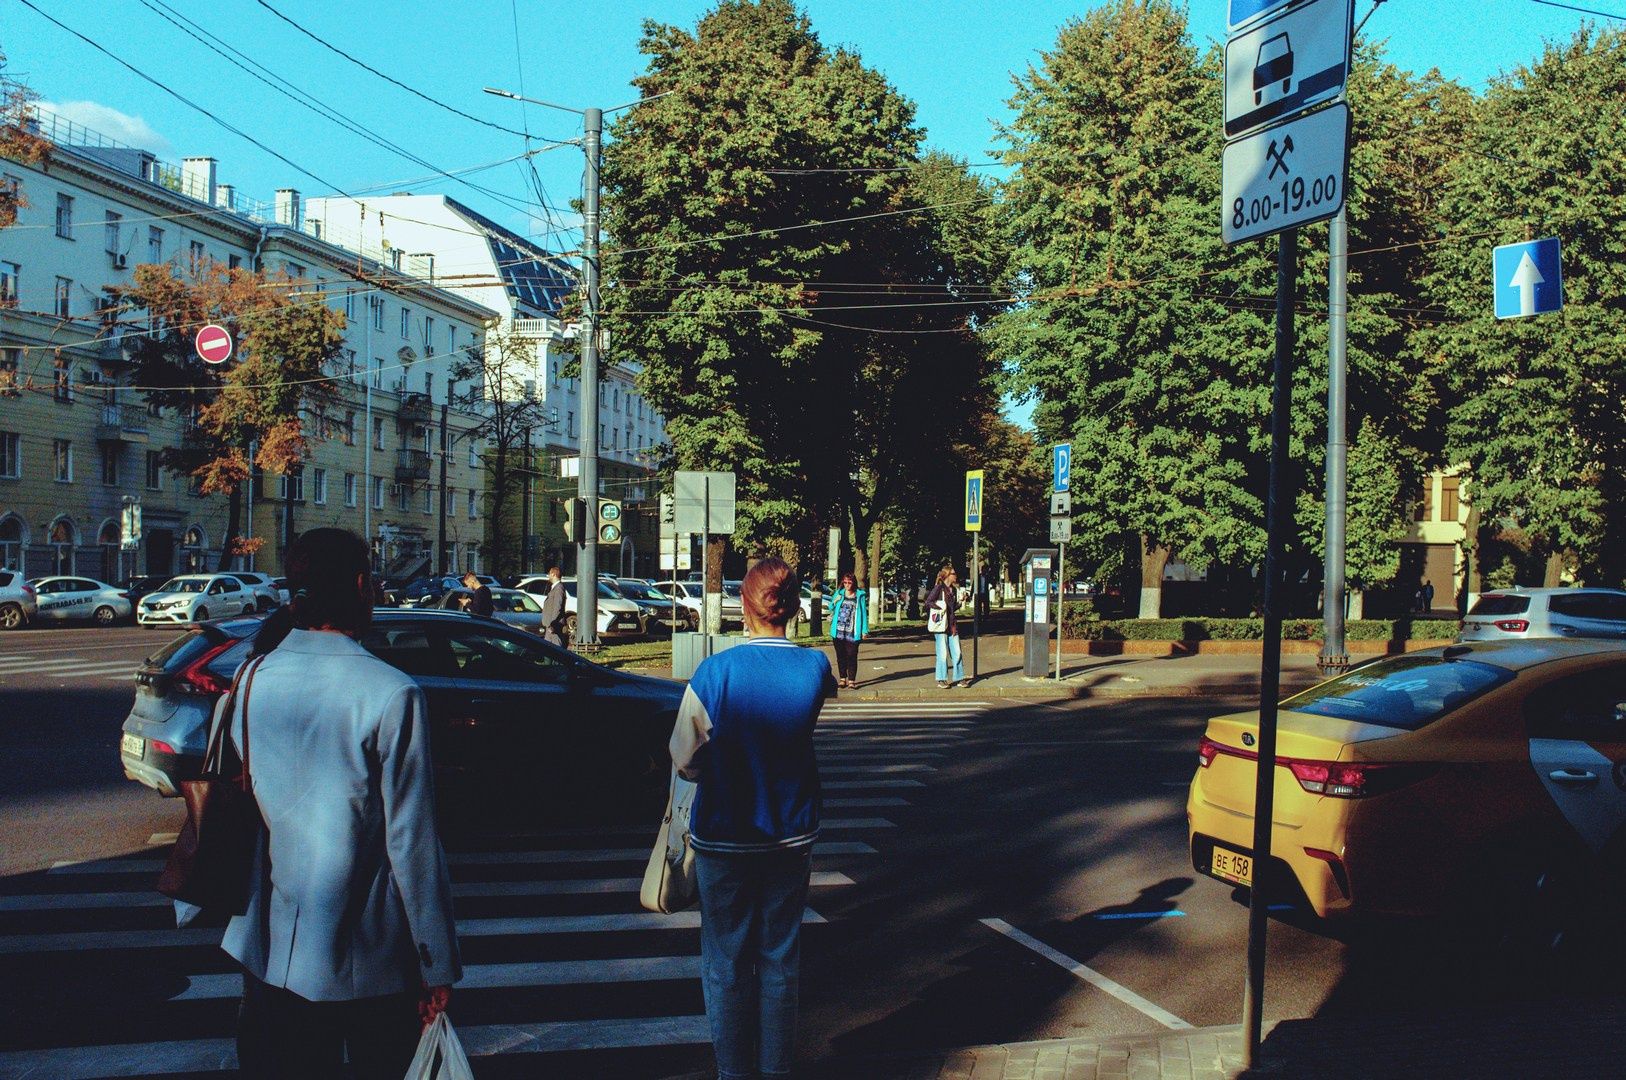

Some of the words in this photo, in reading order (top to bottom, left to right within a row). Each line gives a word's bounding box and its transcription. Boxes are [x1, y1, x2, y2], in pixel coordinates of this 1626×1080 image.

[1232, 174, 1336, 230] 8.00-19.00
[603, 505, 617, 518] 23
[1231, 856, 1249, 877] 158
